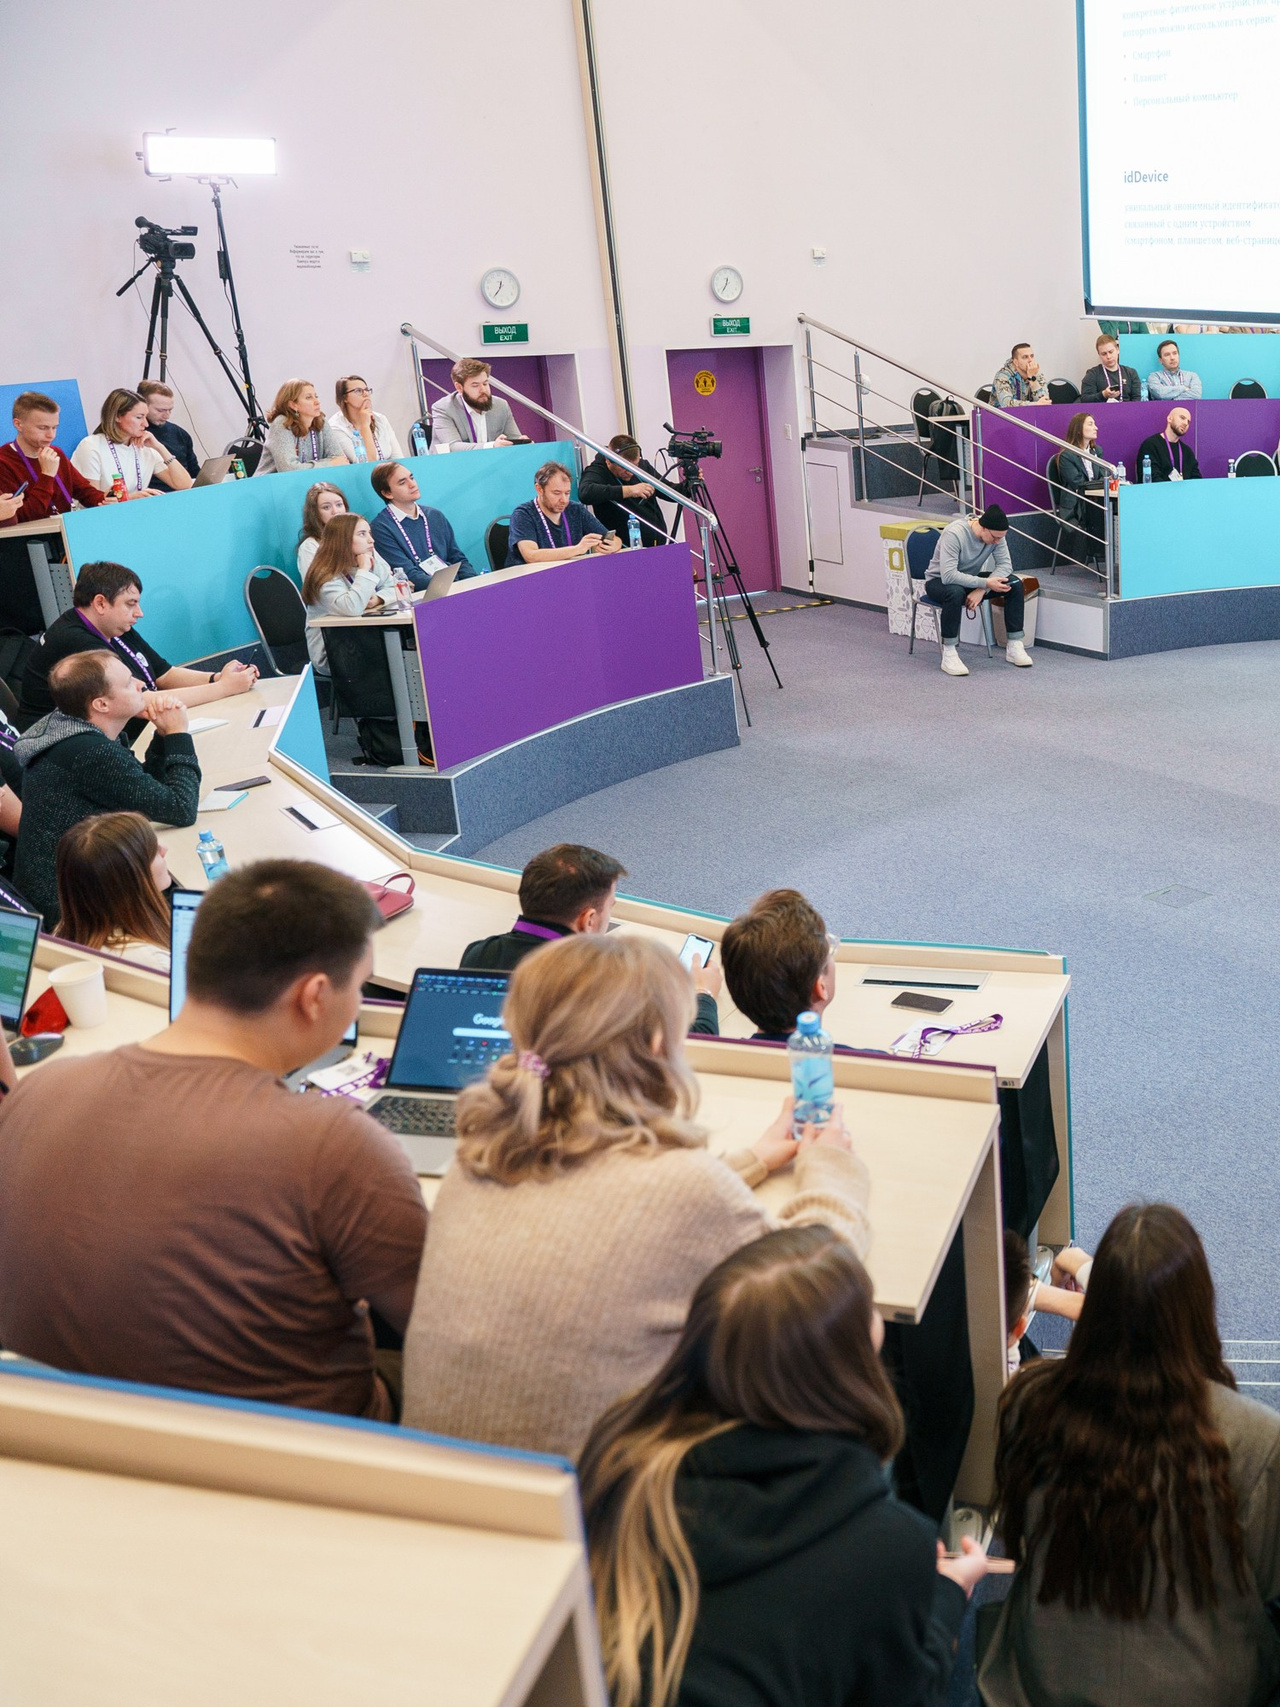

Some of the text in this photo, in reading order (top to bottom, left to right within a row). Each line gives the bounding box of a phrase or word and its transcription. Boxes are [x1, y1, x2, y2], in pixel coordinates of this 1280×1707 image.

[1132, 49, 1171, 61] Смартфон
[1123, 169, 1169, 184] idDevice
[494, 325, 517, 335] ВЫХОД
